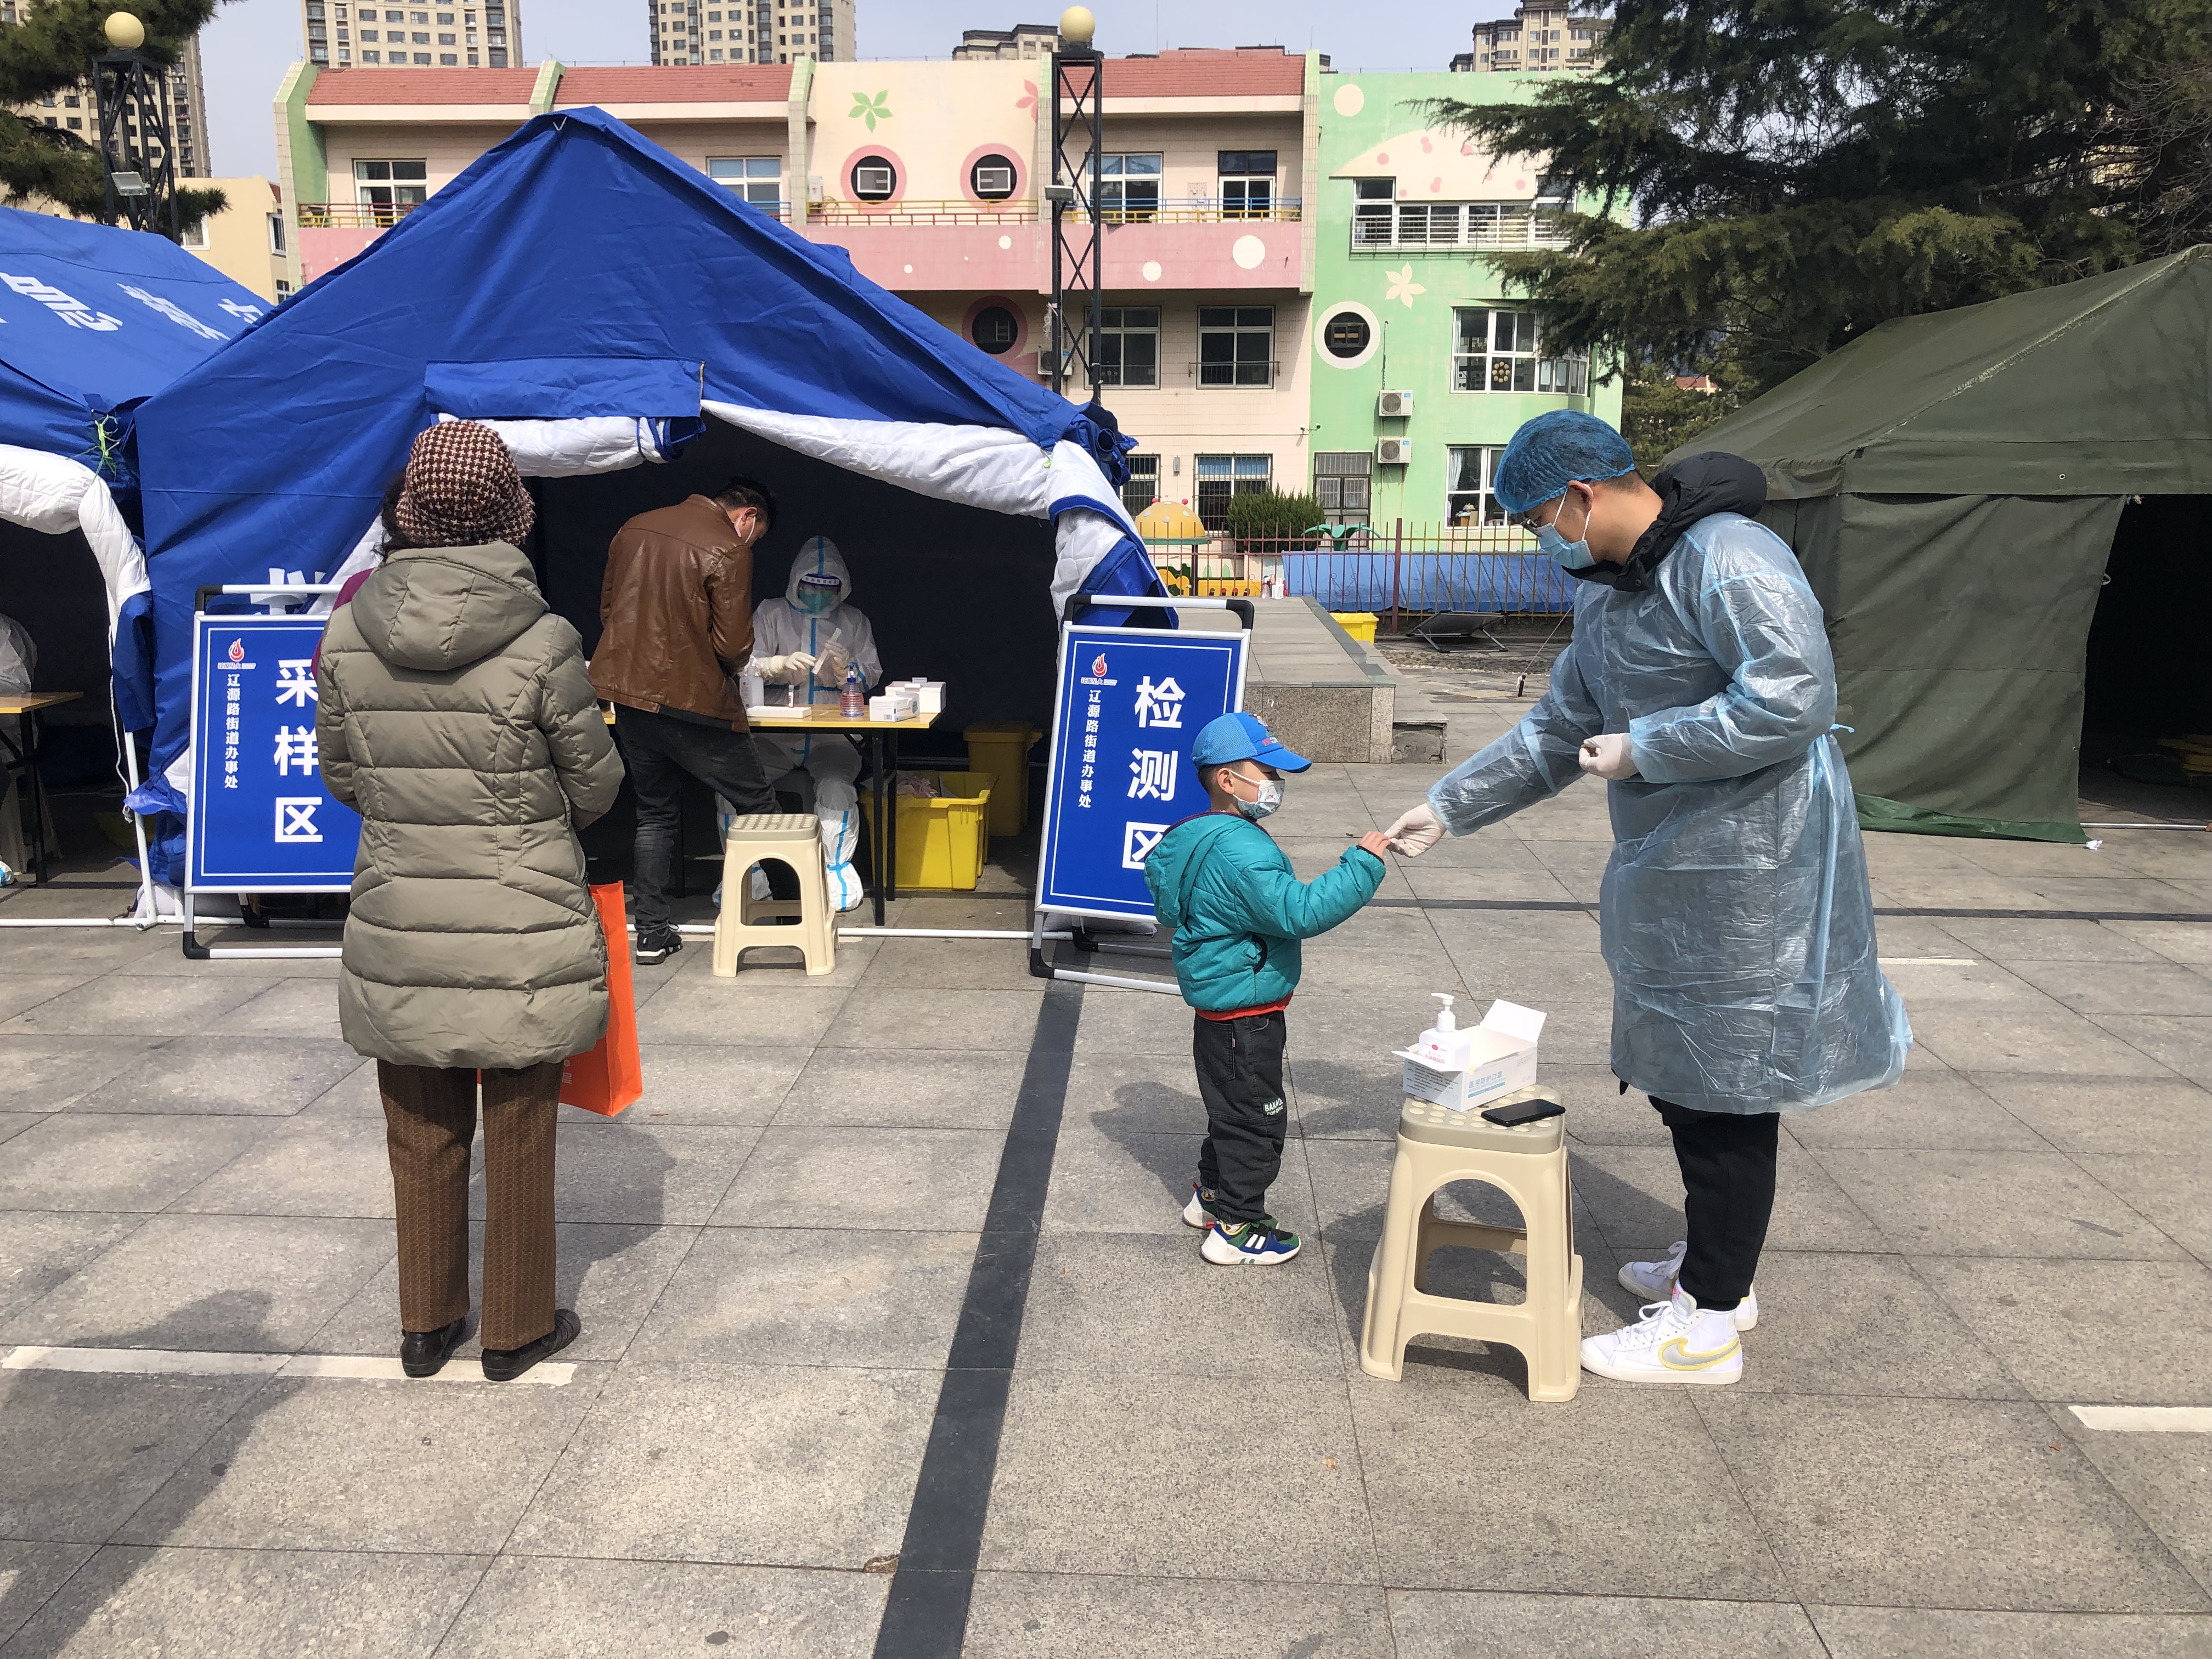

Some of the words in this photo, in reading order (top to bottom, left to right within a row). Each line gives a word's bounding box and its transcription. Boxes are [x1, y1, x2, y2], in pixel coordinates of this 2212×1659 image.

[224, 674, 241, 789] 辽源路街道办事处
[274, 659, 324, 843] 采样区
[1078, 690, 1102, 809] 辽源路街道办事处
[1122, 676, 1186, 870] 检测区
